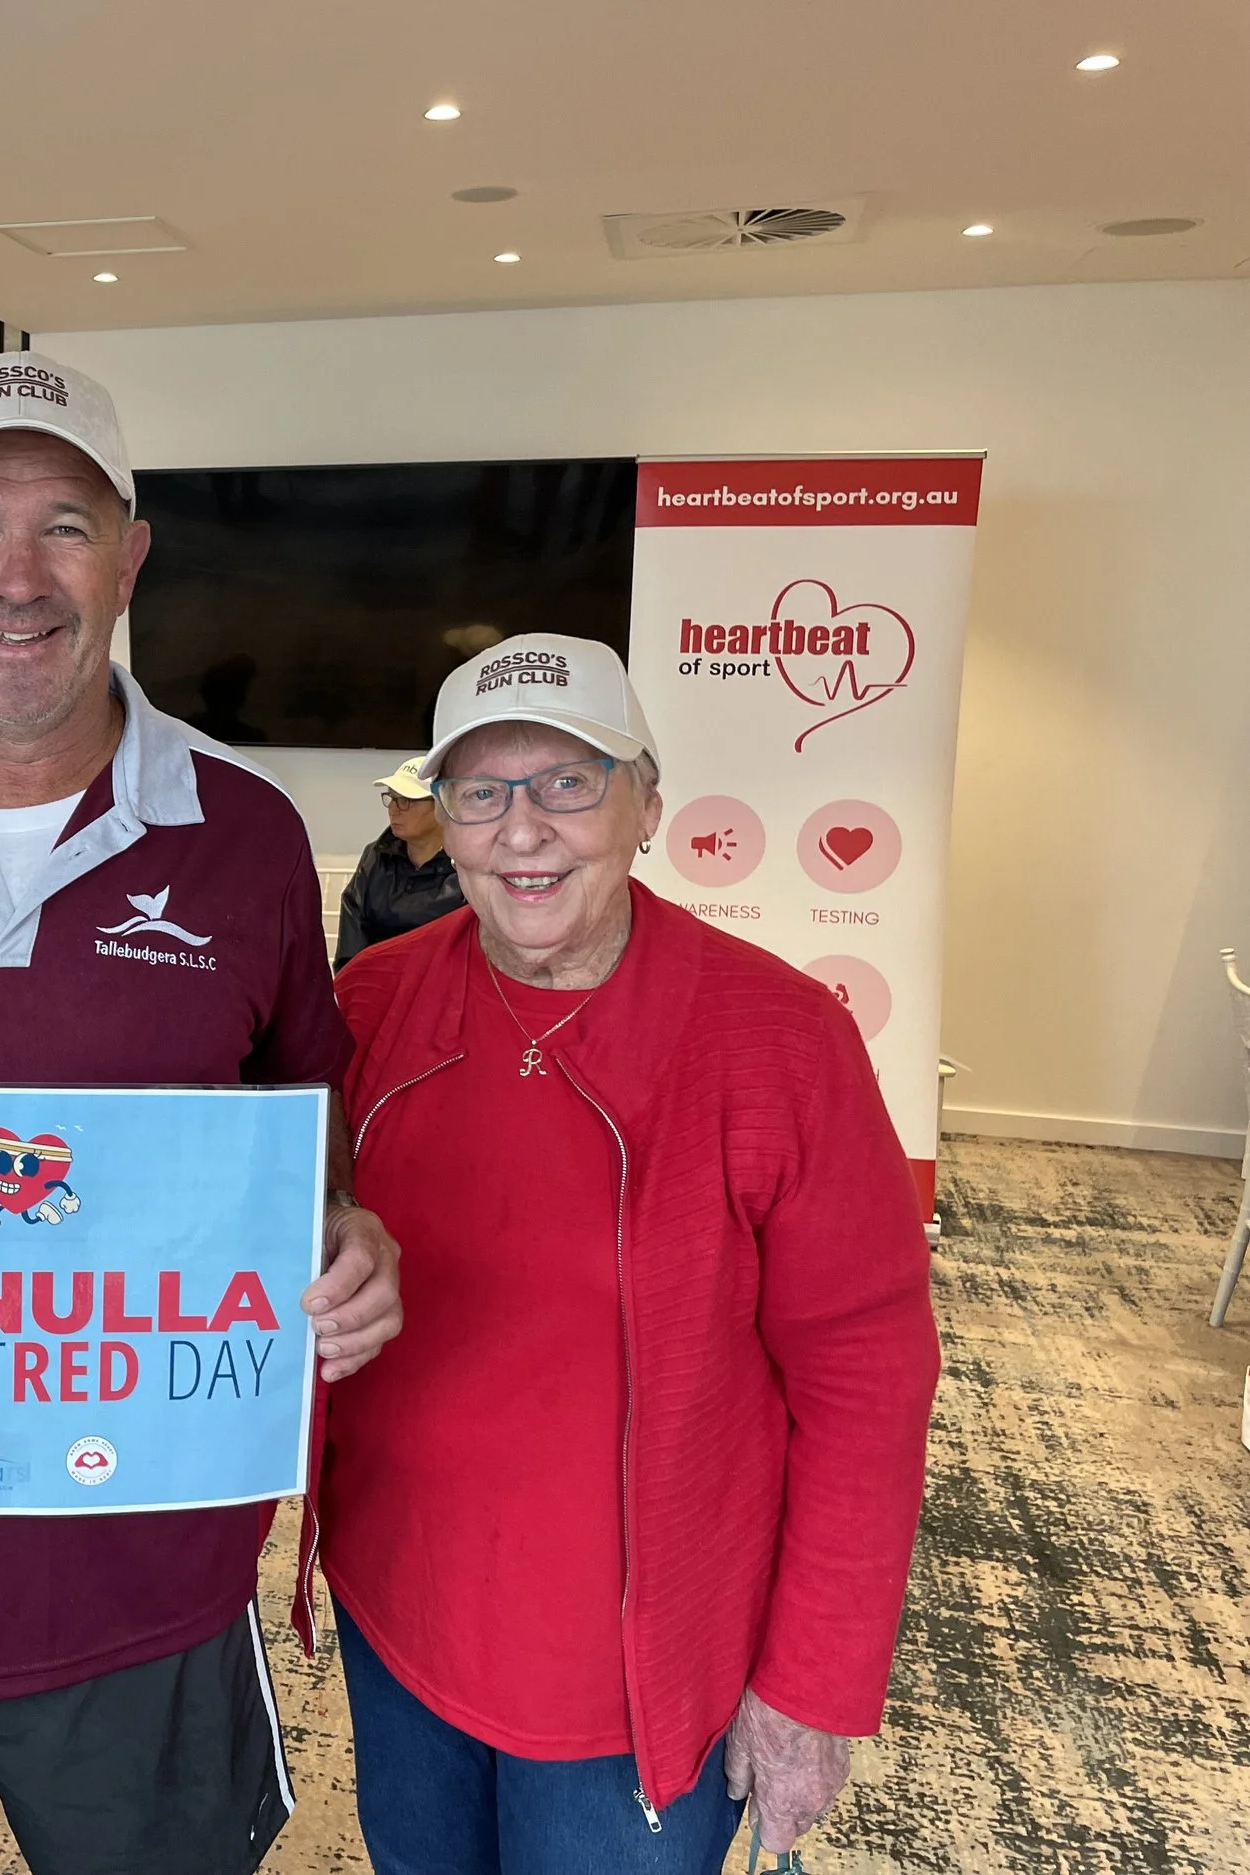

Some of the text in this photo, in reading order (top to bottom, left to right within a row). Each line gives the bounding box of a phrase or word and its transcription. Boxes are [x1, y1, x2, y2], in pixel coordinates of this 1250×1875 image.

[17, 385, 67, 407] CLUB
[657, 485, 958, 511] heartbeatofsport.org.au
[679, 618, 871, 656] heartbeat
[480, 652, 568, 679] ROSSCO'S
[679, 658, 771, 680] of sport
[475, 671, 568, 696] RUN CLUB
[680, 902, 761, 919] ARENESS
[810, 908, 880, 926] TESTING
[94, 940, 177, 965] Tallebudgera
[169, 1338, 275, 1401] DAY
